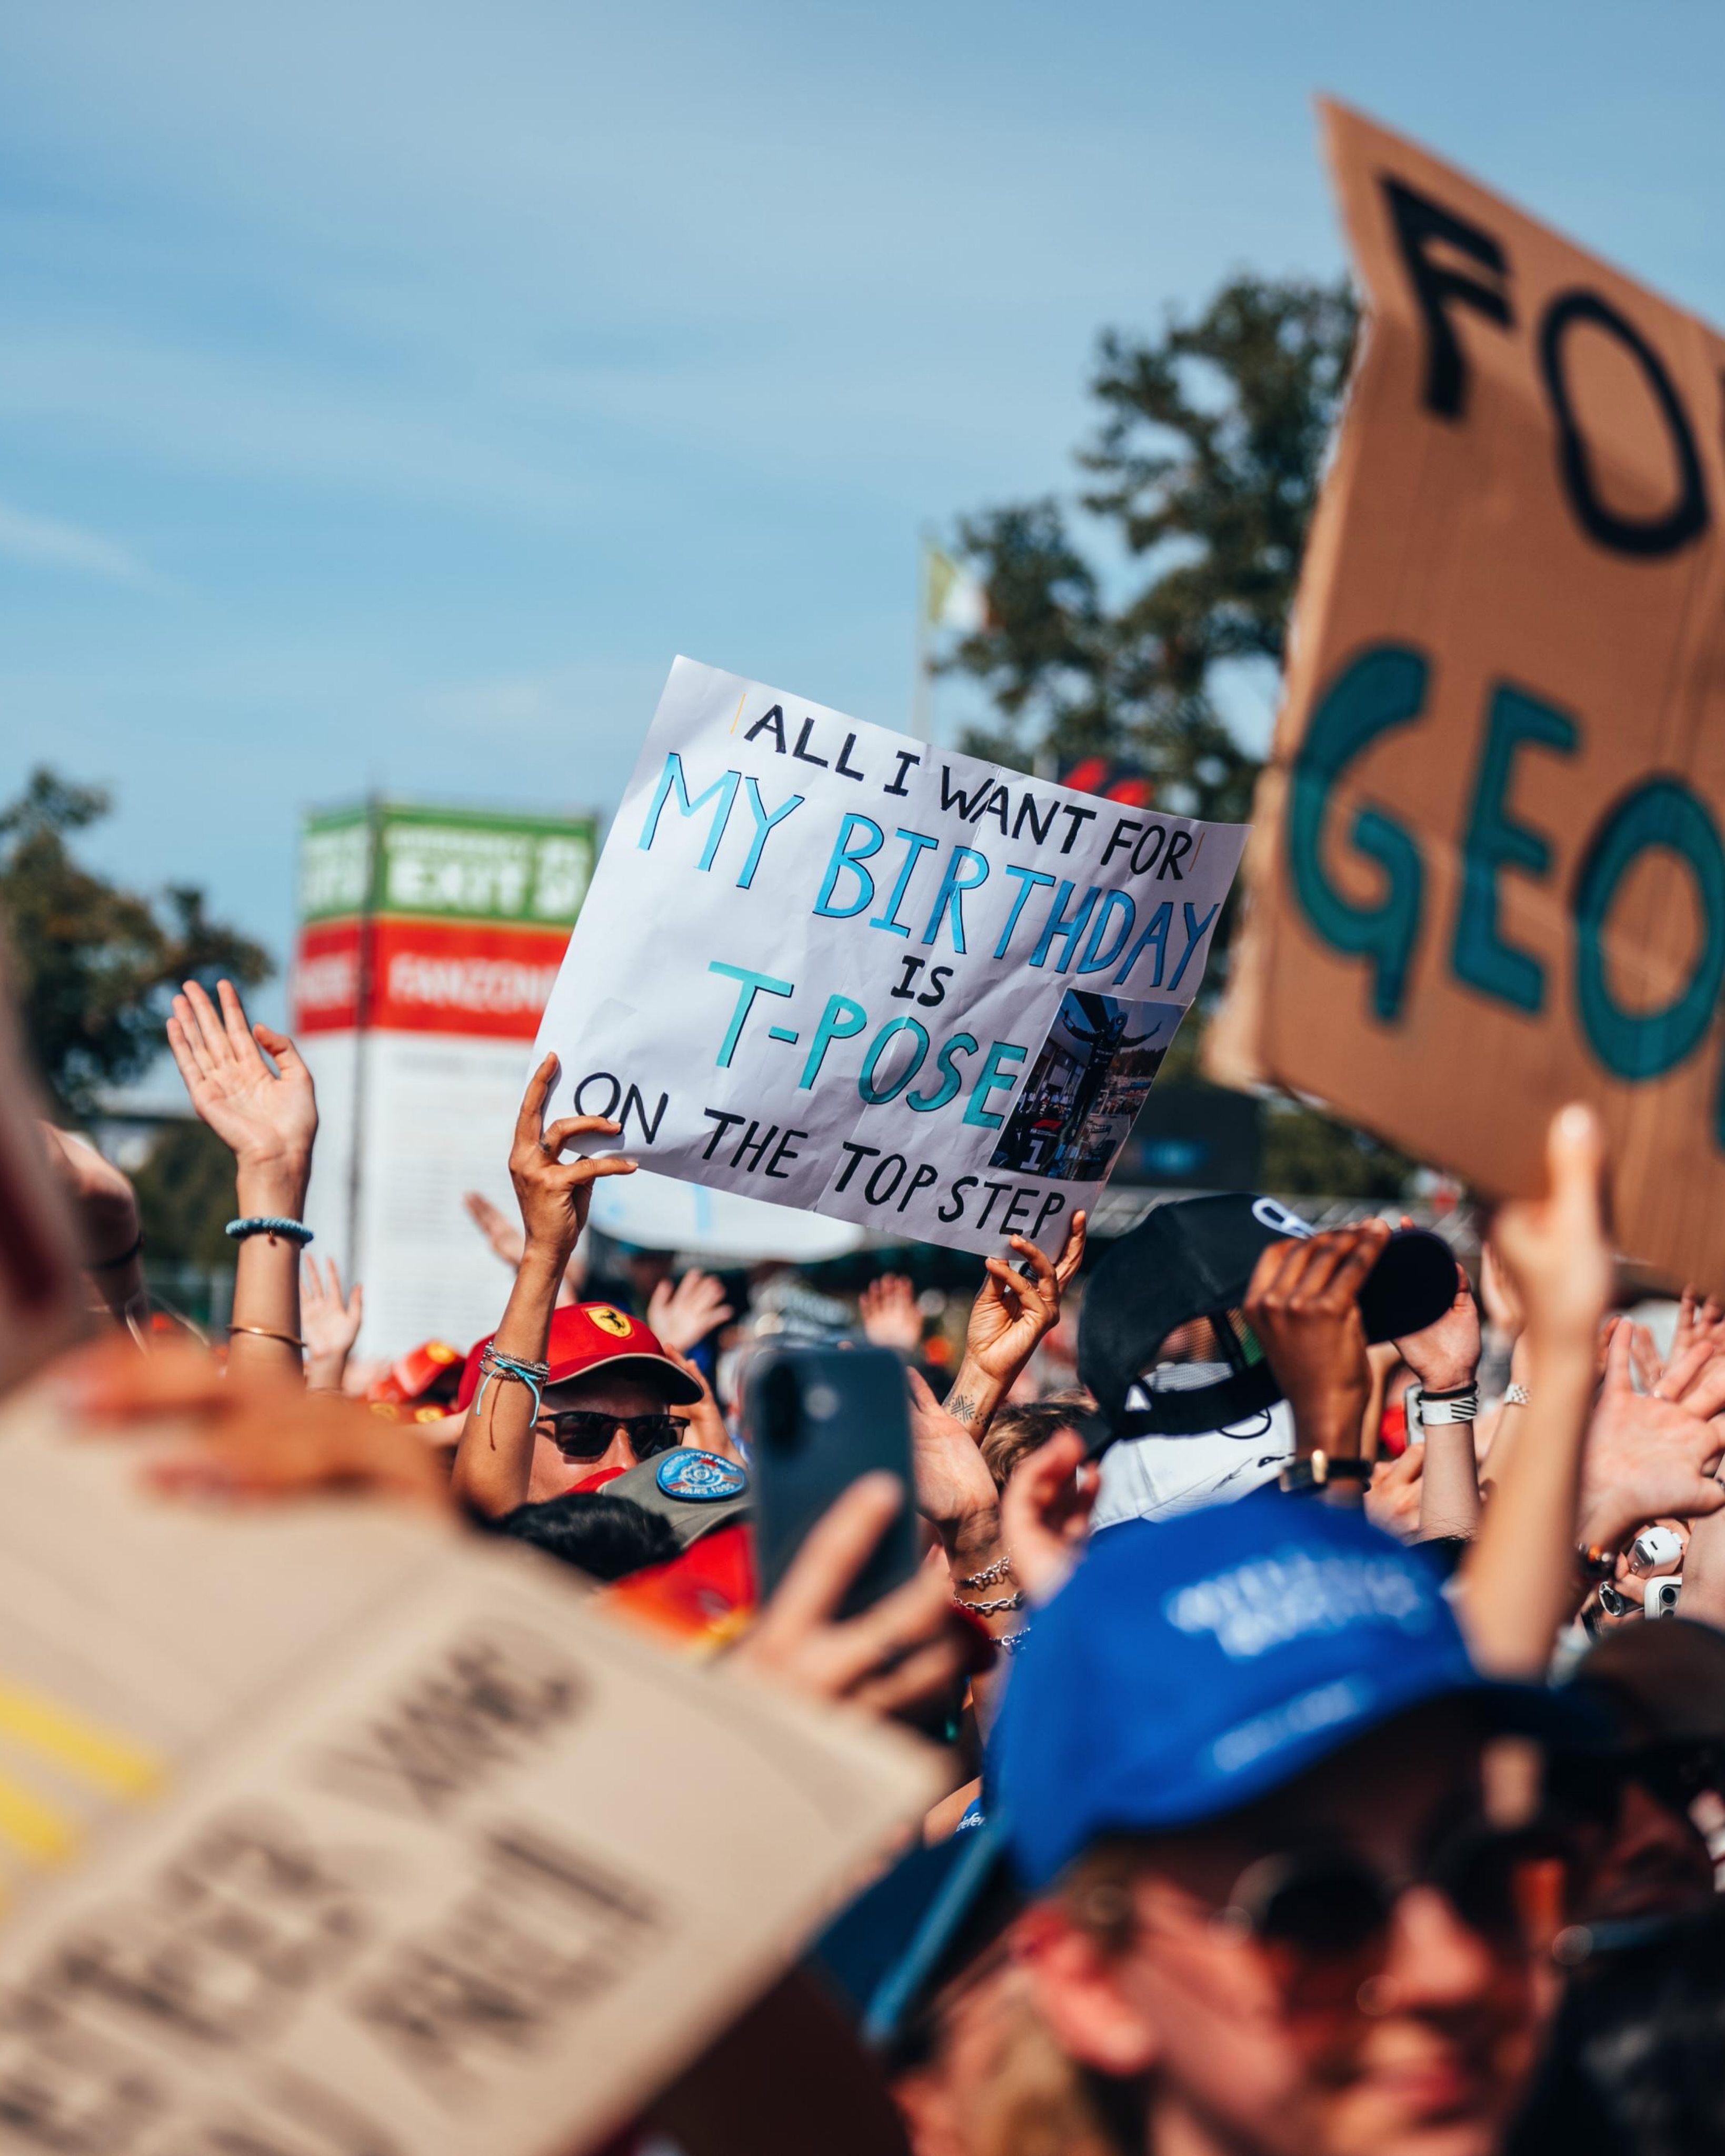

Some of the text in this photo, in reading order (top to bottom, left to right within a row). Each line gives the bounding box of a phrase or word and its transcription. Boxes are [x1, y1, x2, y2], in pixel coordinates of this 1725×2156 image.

[1375, 164, 1725, 570] FO
[636, 752, 804, 889] MY
[812, 813, 1220, 991] BIRTHDAY
[743, 704, 1193, 880] ALL I WANT FOR
[891, 955, 954, 1006] IS
[1284, 640, 1725, 1155] GEO
[709, 961, 1029, 1130] T-POSE
[574, 1072, 1066, 1239] ON THE TOP STEP
